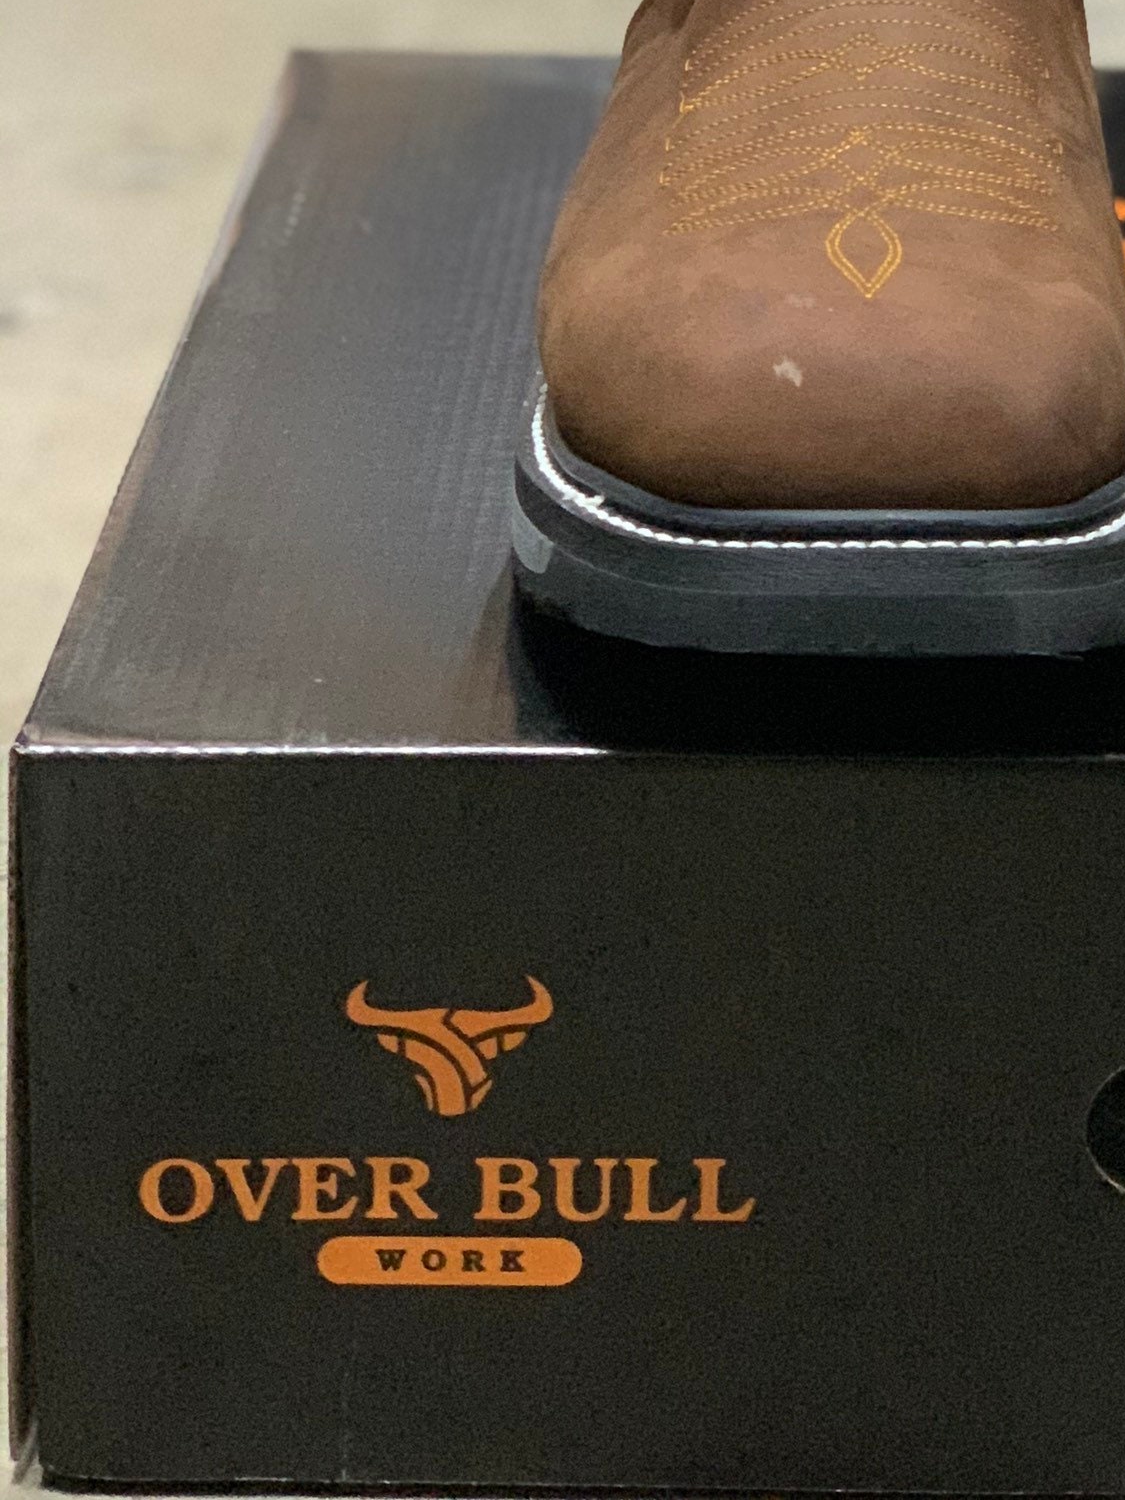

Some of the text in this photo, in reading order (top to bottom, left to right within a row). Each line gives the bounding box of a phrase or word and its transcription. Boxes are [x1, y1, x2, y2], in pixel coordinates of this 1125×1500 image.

[139, 1157, 756, 1223] OVER BULL
[376, 1248, 526, 1273] WORK
